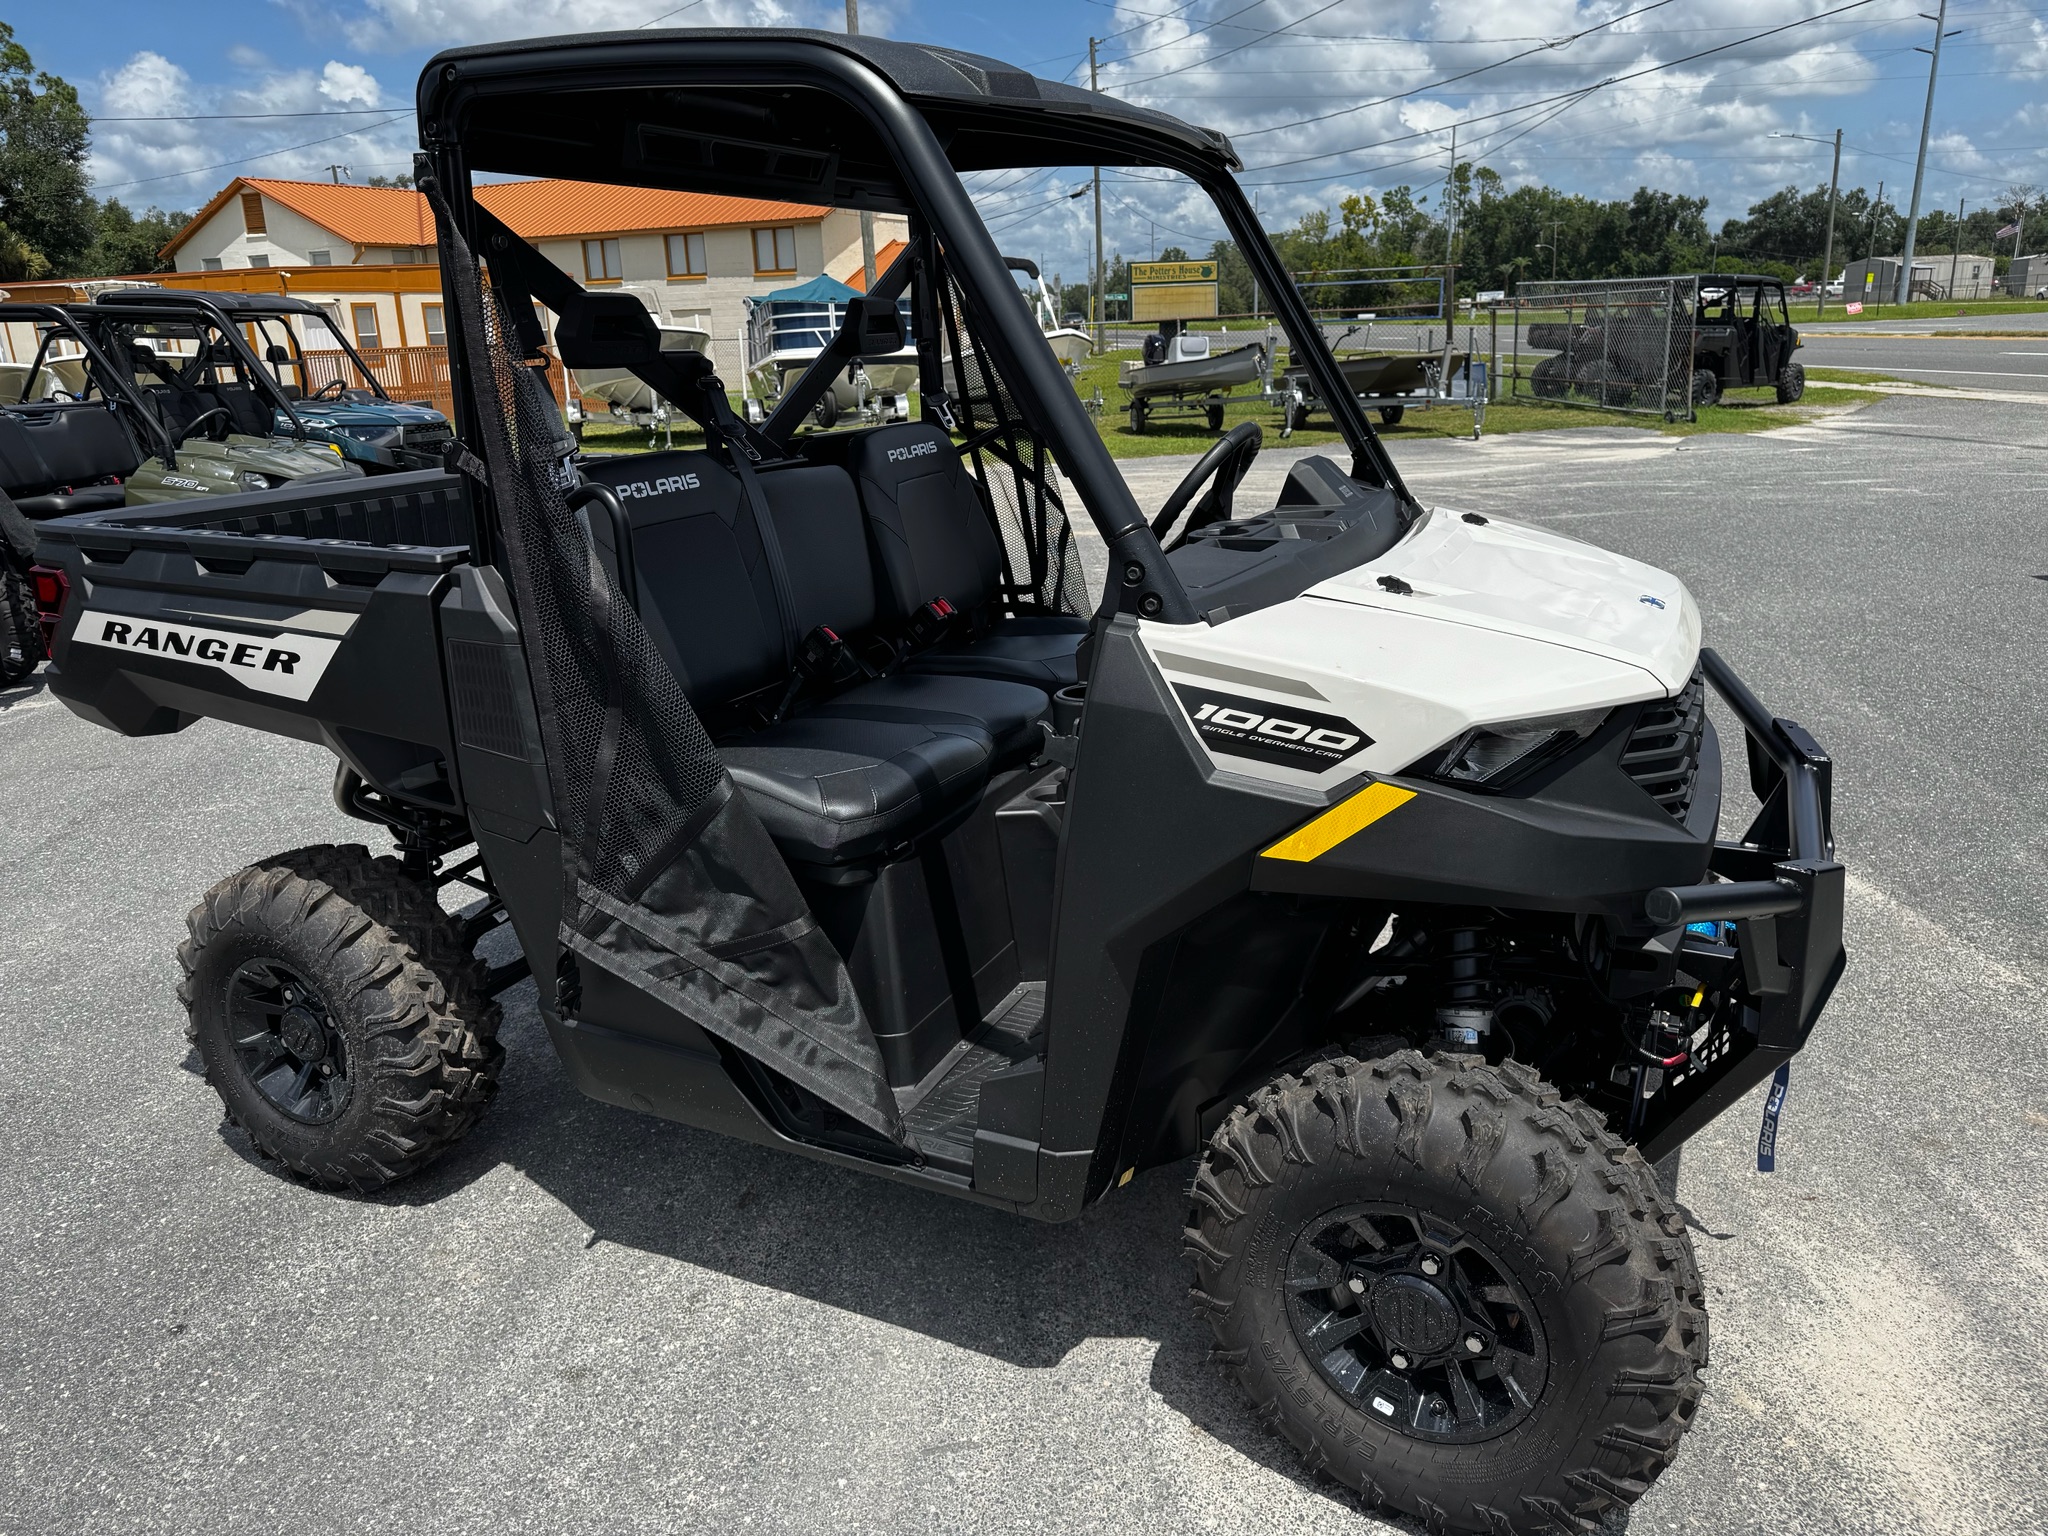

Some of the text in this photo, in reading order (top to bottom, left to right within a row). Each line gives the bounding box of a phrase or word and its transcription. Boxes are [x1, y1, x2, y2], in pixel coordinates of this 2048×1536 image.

[1134, 264, 1201, 276] The Potter's House
[887, 440, 938, 463] POLARIS
[161, 476, 199, 489] 570
[615, 472, 701, 501] POLARIS
[101, 620, 301, 675] RANGER
[1193, 703, 1360, 751] 1000
[1201, 724, 1343, 759] SINGLE OVERHEAD CAM
[1760, 1082, 1784, 1157] POLARIS
[1261, 1340, 1378, 1461] CARLSTAR
